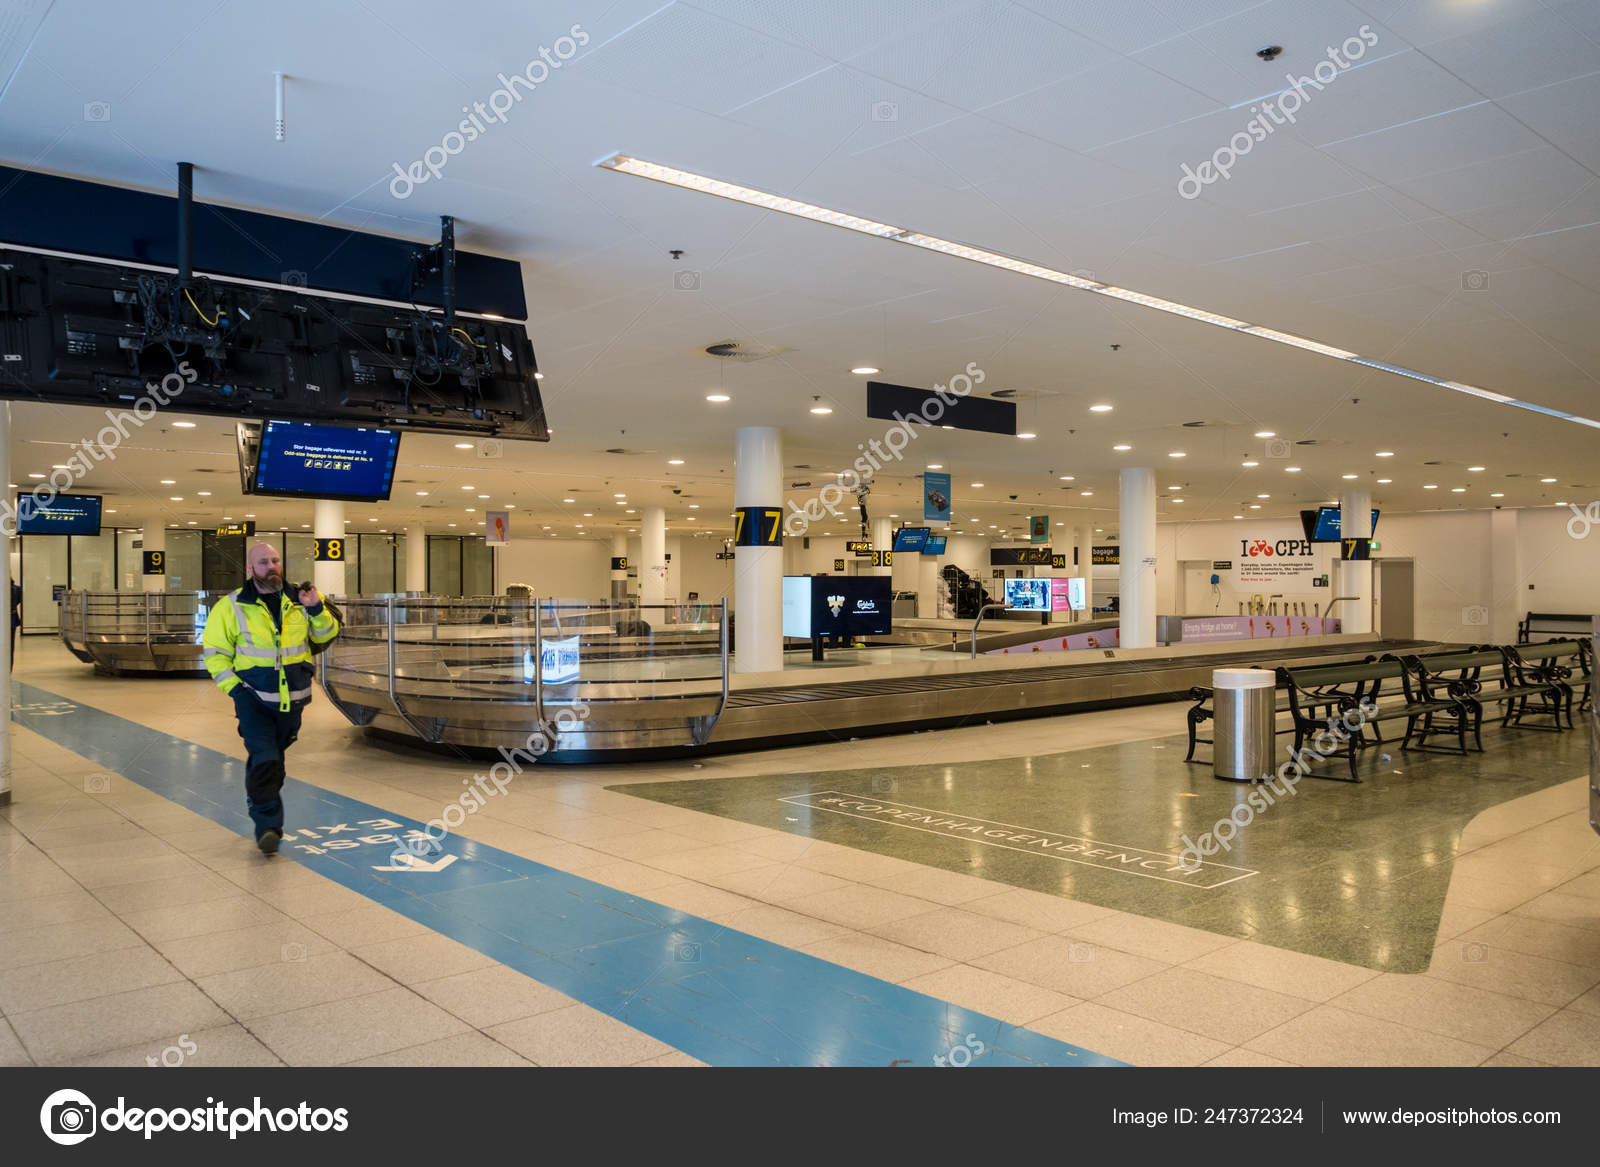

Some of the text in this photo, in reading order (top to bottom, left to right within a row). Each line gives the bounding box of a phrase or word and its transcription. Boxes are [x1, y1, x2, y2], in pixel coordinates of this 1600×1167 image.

[765, 511, 780, 542] 7
[328, 540, 342, 559] 8
[1275, 540, 1314, 556] CPH
[1345, 540, 1357, 558] 7
[152, 552, 162, 566] 9
[620, 558, 626, 569] 9
[884, 552, 892, 565] 8
[1052, 556, 1064, 566] 9A
[819, 797, 1203, 876] #COPENHAGENBENCH
